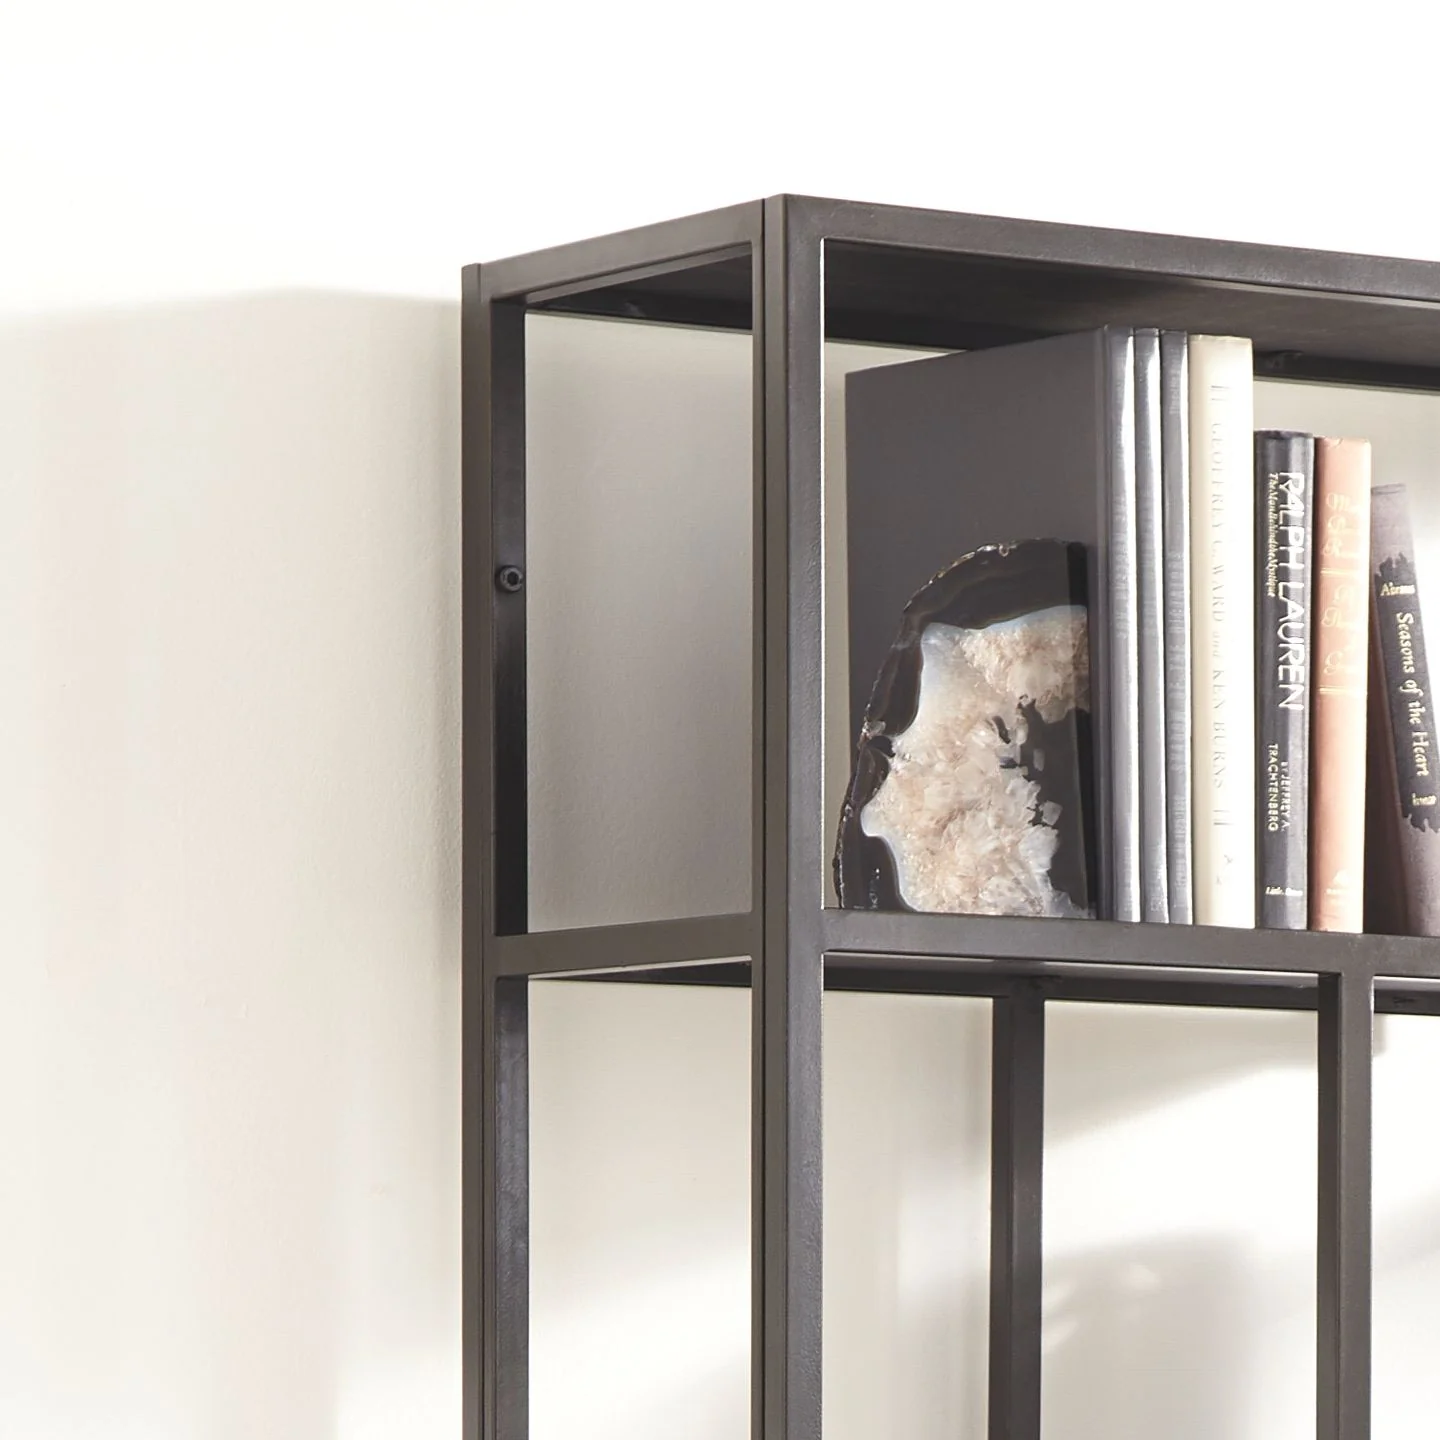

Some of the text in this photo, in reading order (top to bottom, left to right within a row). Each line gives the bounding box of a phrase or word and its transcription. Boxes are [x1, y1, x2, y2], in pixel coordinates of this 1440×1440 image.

[1277, 472, 1305, 711] RALPH LAUREN
[1396, 612, 1416, 674] Seasons
[1399, 679, 1424, 697] of
[1408, 700, 1426, 725] the
[1411, 731, 1430, 777] Heart
[1268, 743, 1279, 832] TRACHTENBERG
